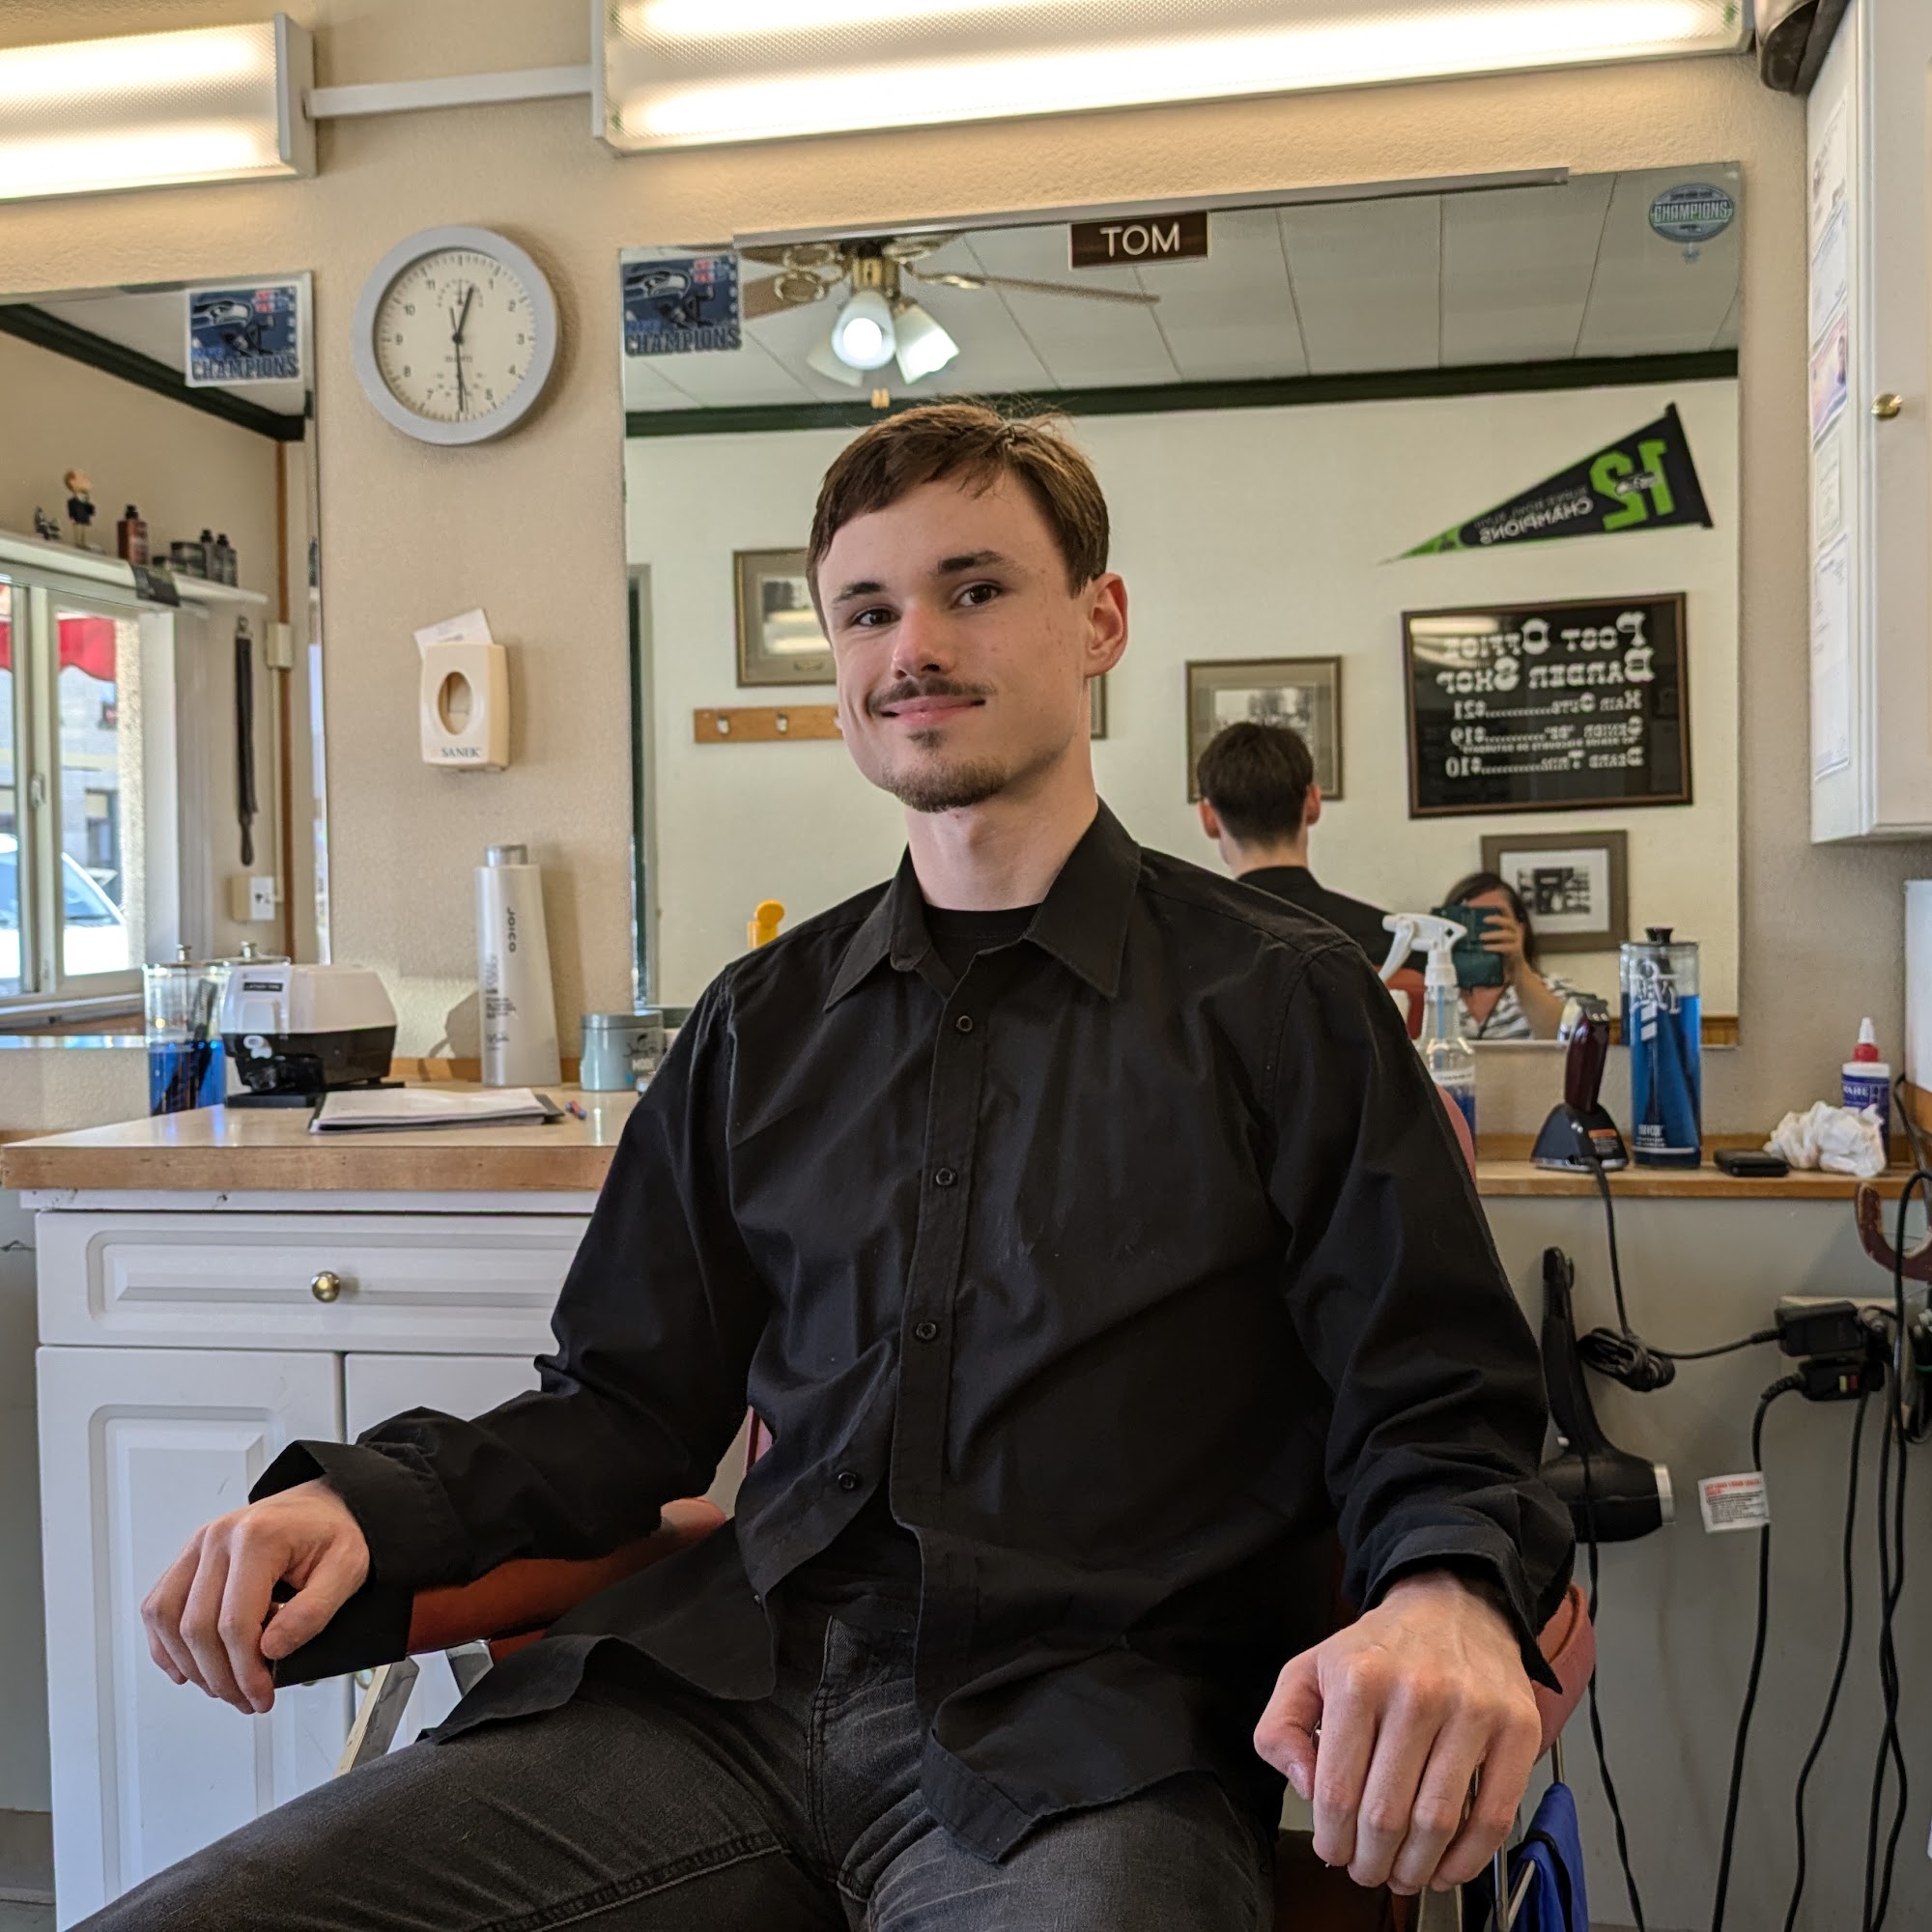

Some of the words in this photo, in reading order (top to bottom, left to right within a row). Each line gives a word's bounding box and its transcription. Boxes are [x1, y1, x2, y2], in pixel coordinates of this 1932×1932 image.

[1654, 201, 1728, 223] CHAMPIONS
[1099, 221, 1180, 257] TOM
[626, 325, 741, 354] CHAMPIONS
[192, 351, 299, 380] CHAMPIONS
[506, 907, 517, 952] JOICO
